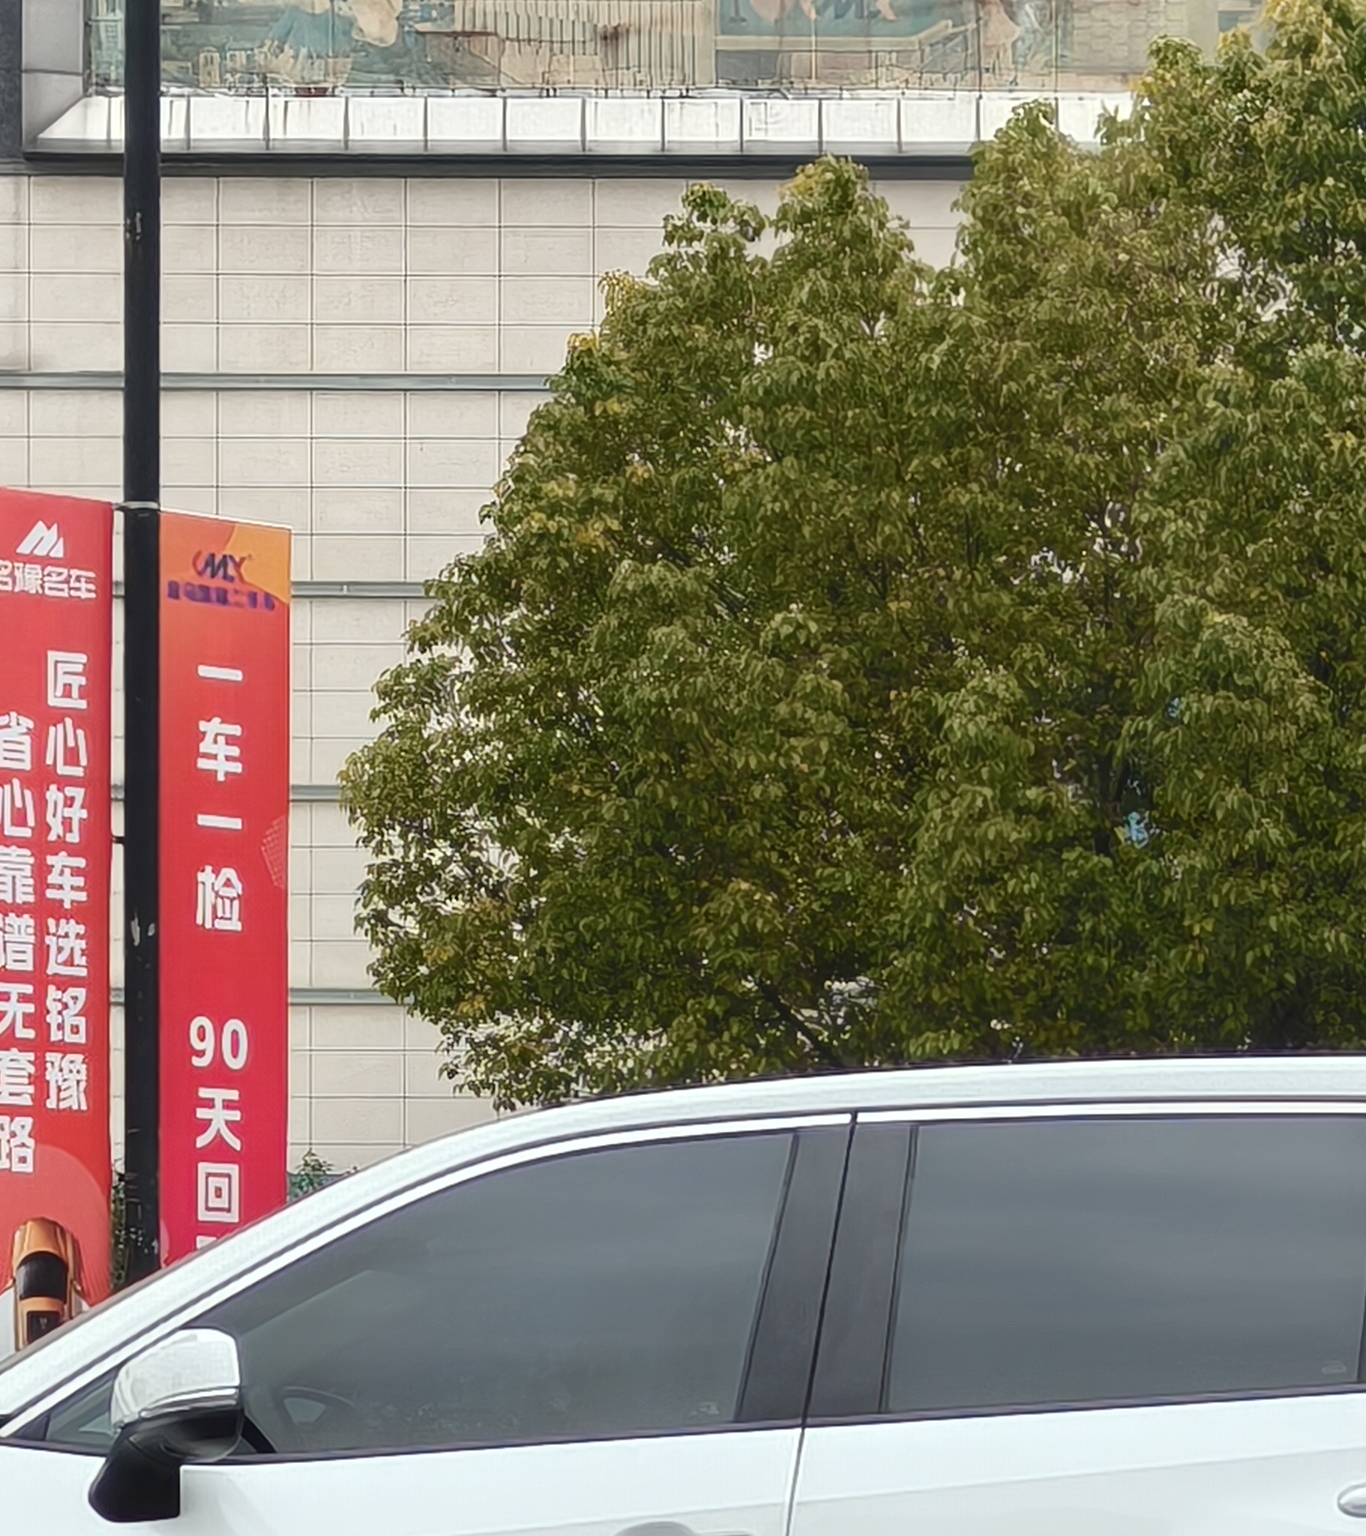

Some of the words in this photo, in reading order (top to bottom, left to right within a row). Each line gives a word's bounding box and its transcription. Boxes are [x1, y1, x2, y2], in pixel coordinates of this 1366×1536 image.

[45, 651, 89, 1112] 匠心好车选铭豫
[197, 664, 243, 932] 一车一检
[195, 1088, 243, 1250] 天回
